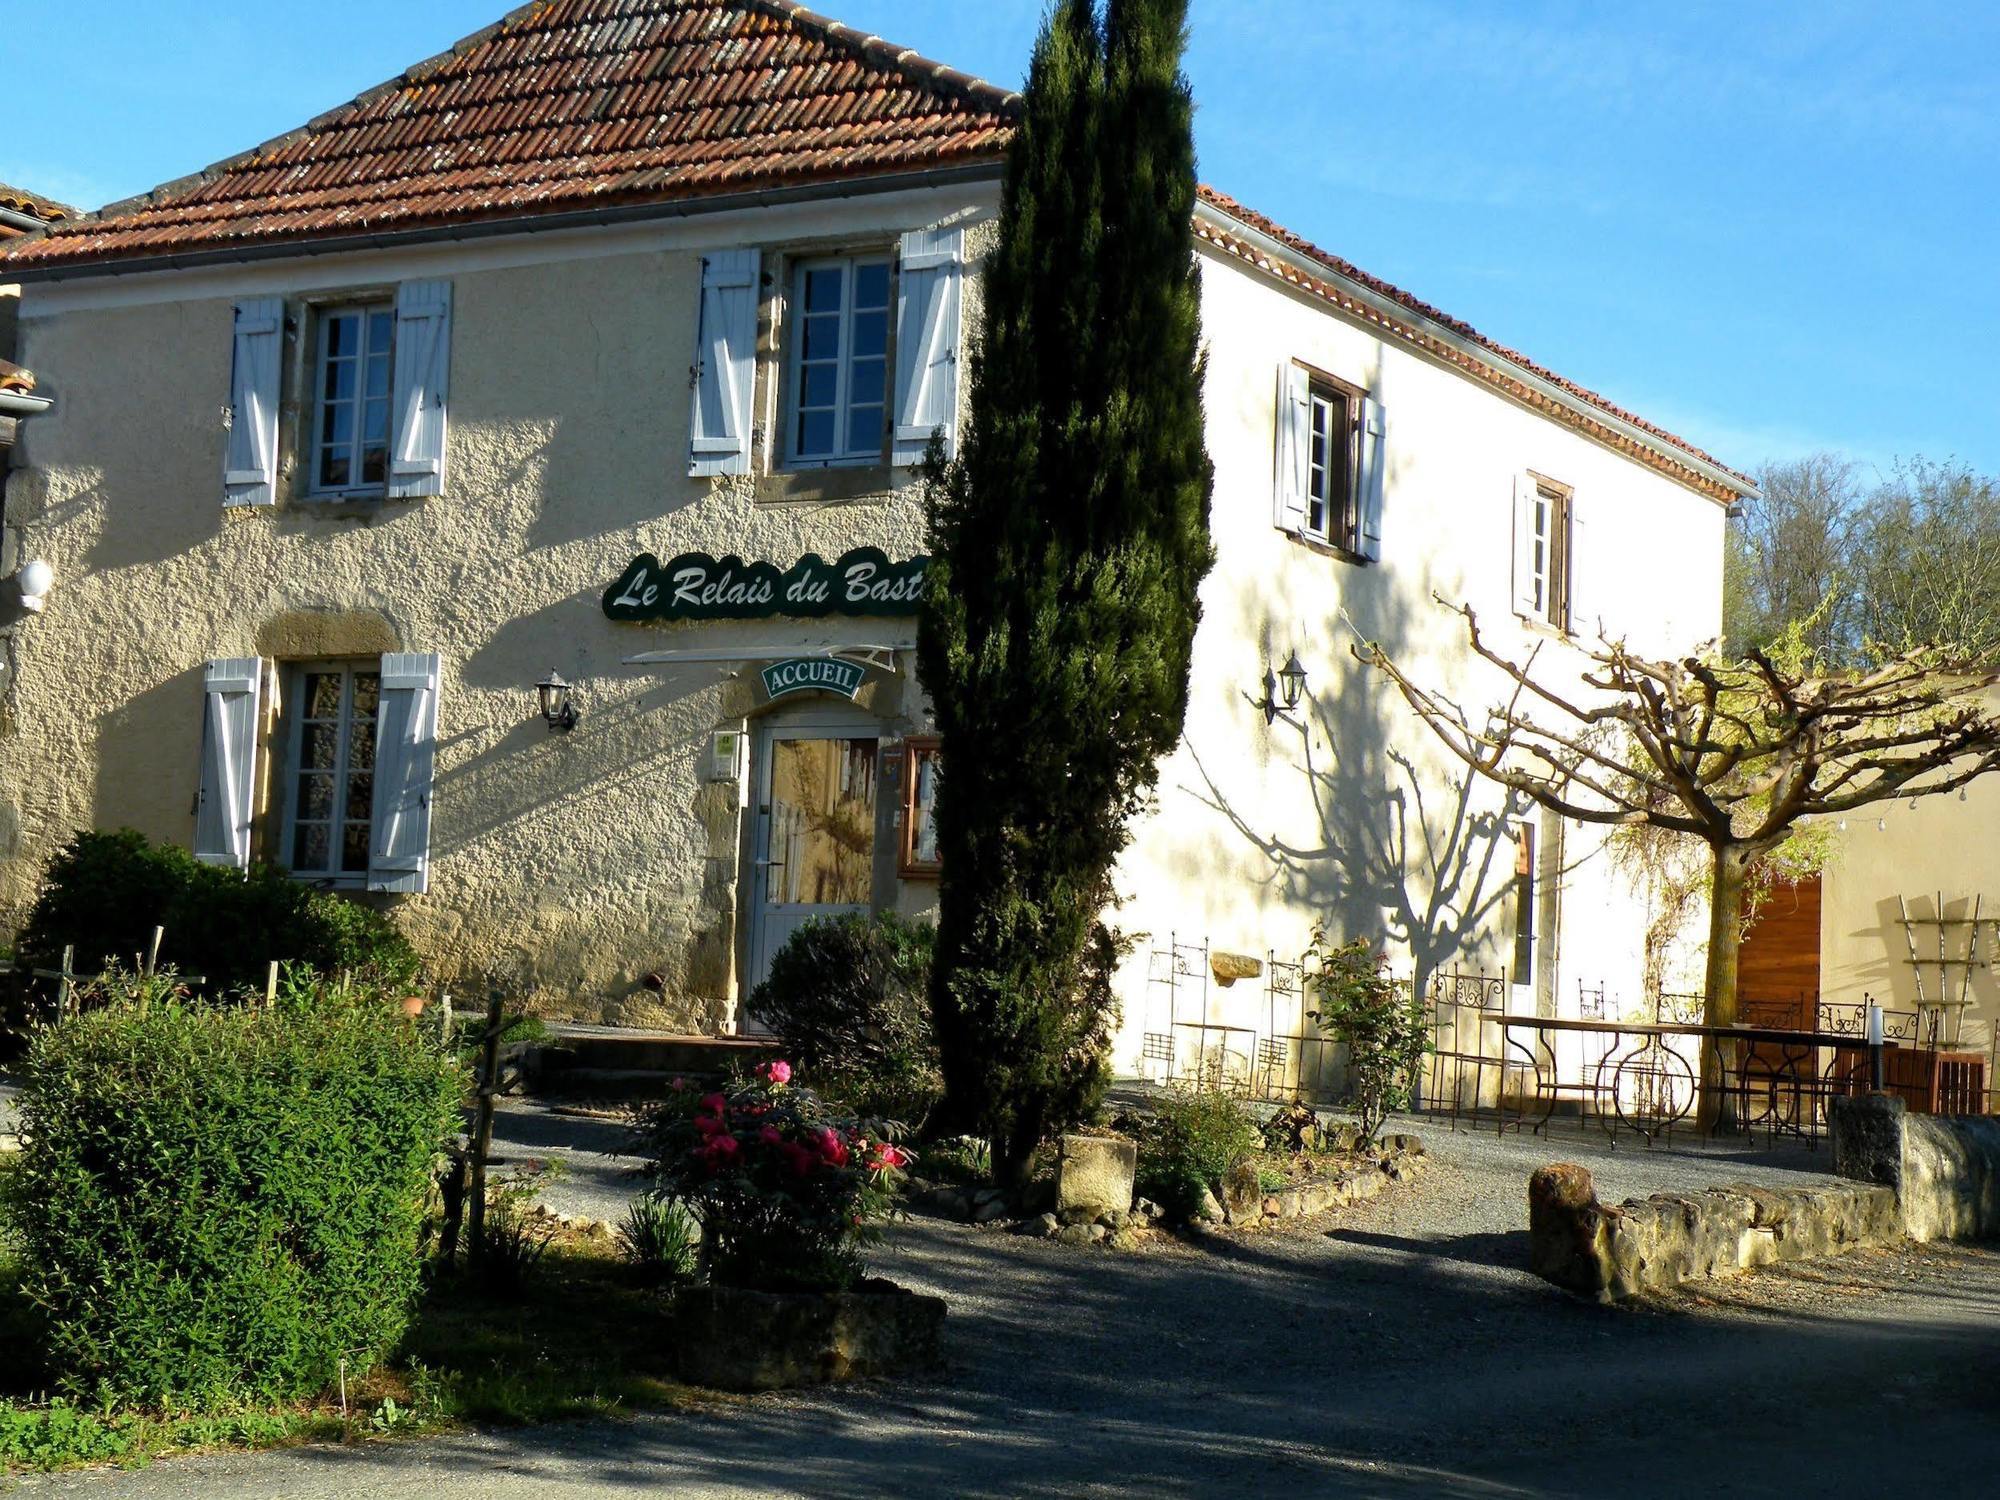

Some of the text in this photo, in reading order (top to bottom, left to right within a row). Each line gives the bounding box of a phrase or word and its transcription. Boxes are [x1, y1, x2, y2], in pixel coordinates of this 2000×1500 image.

[613, 562, 926, 607] Le Relais du Bast
[770, 663, 854, 692] ACCUEIL
